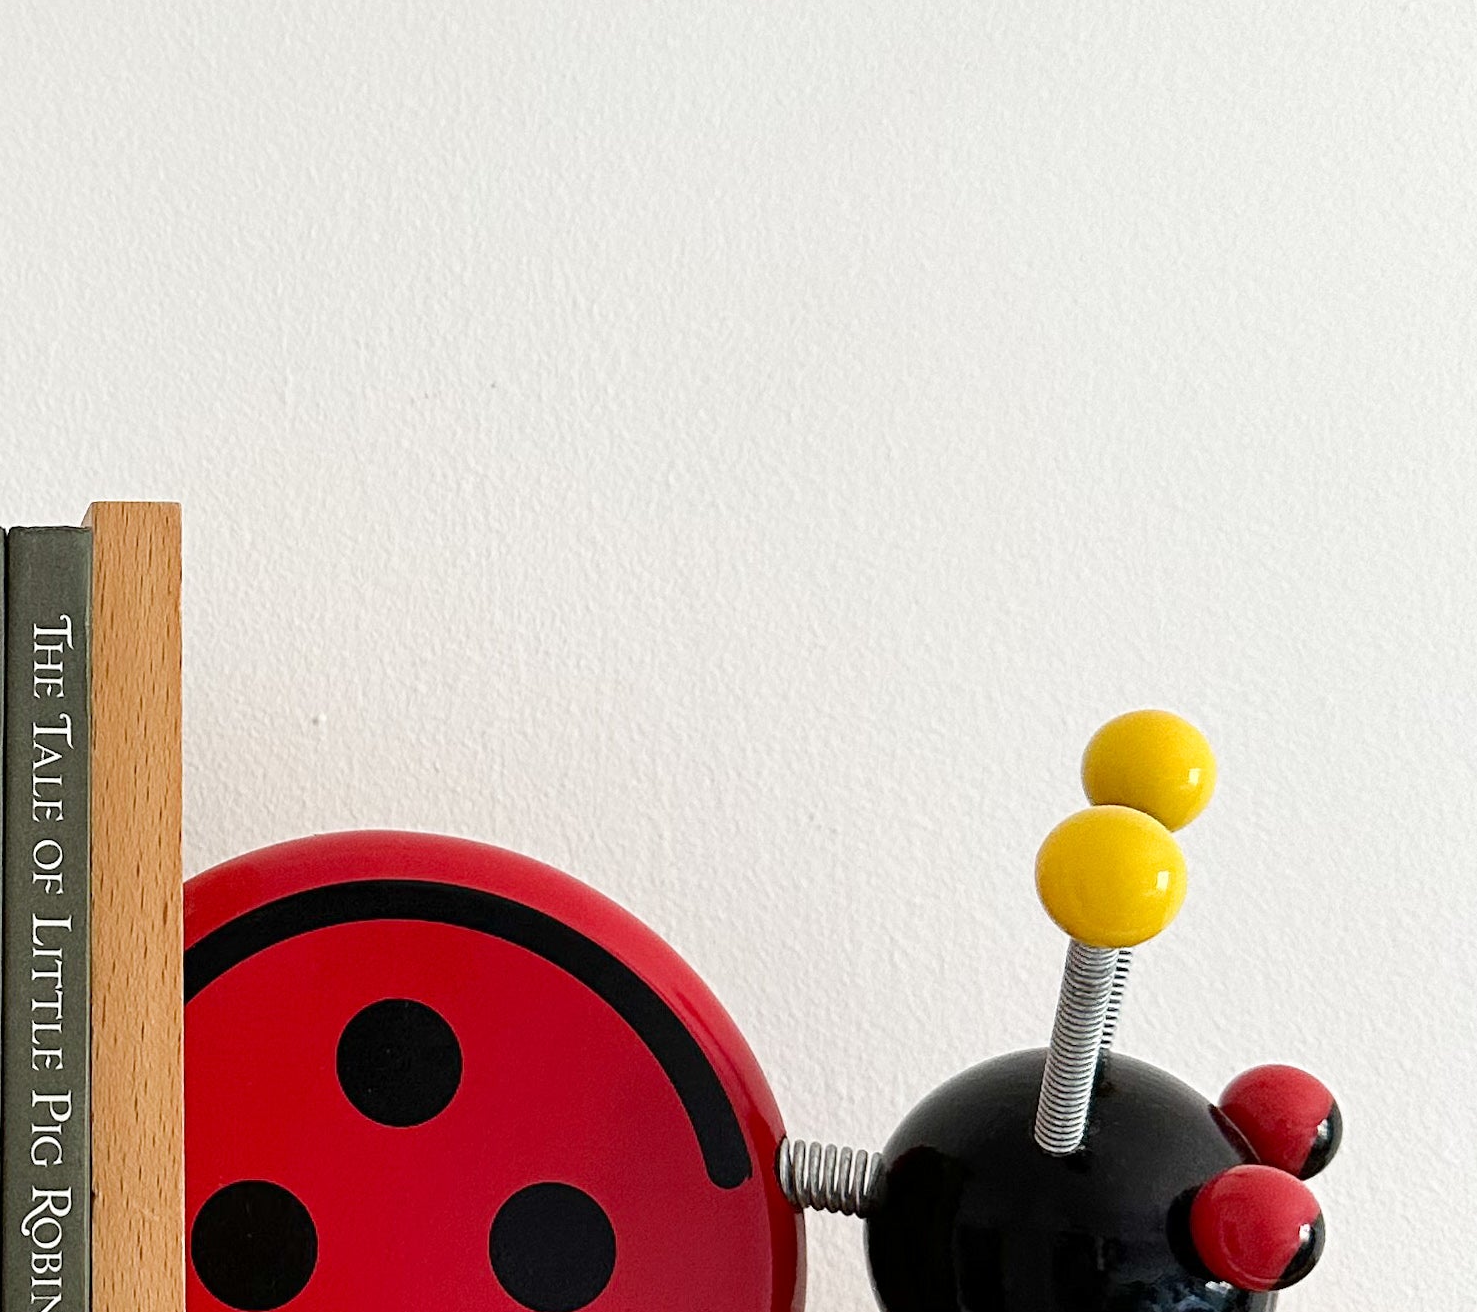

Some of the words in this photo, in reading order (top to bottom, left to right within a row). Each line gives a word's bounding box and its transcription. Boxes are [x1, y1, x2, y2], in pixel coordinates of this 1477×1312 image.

[33, 614, 74, 699] THE
[32, 713, 74, 823] TALE
[32, 839, 64, 895] OF
[31, 912, 72, 1071] LITTLE
[30, 1089, 72, 1168] PIG
